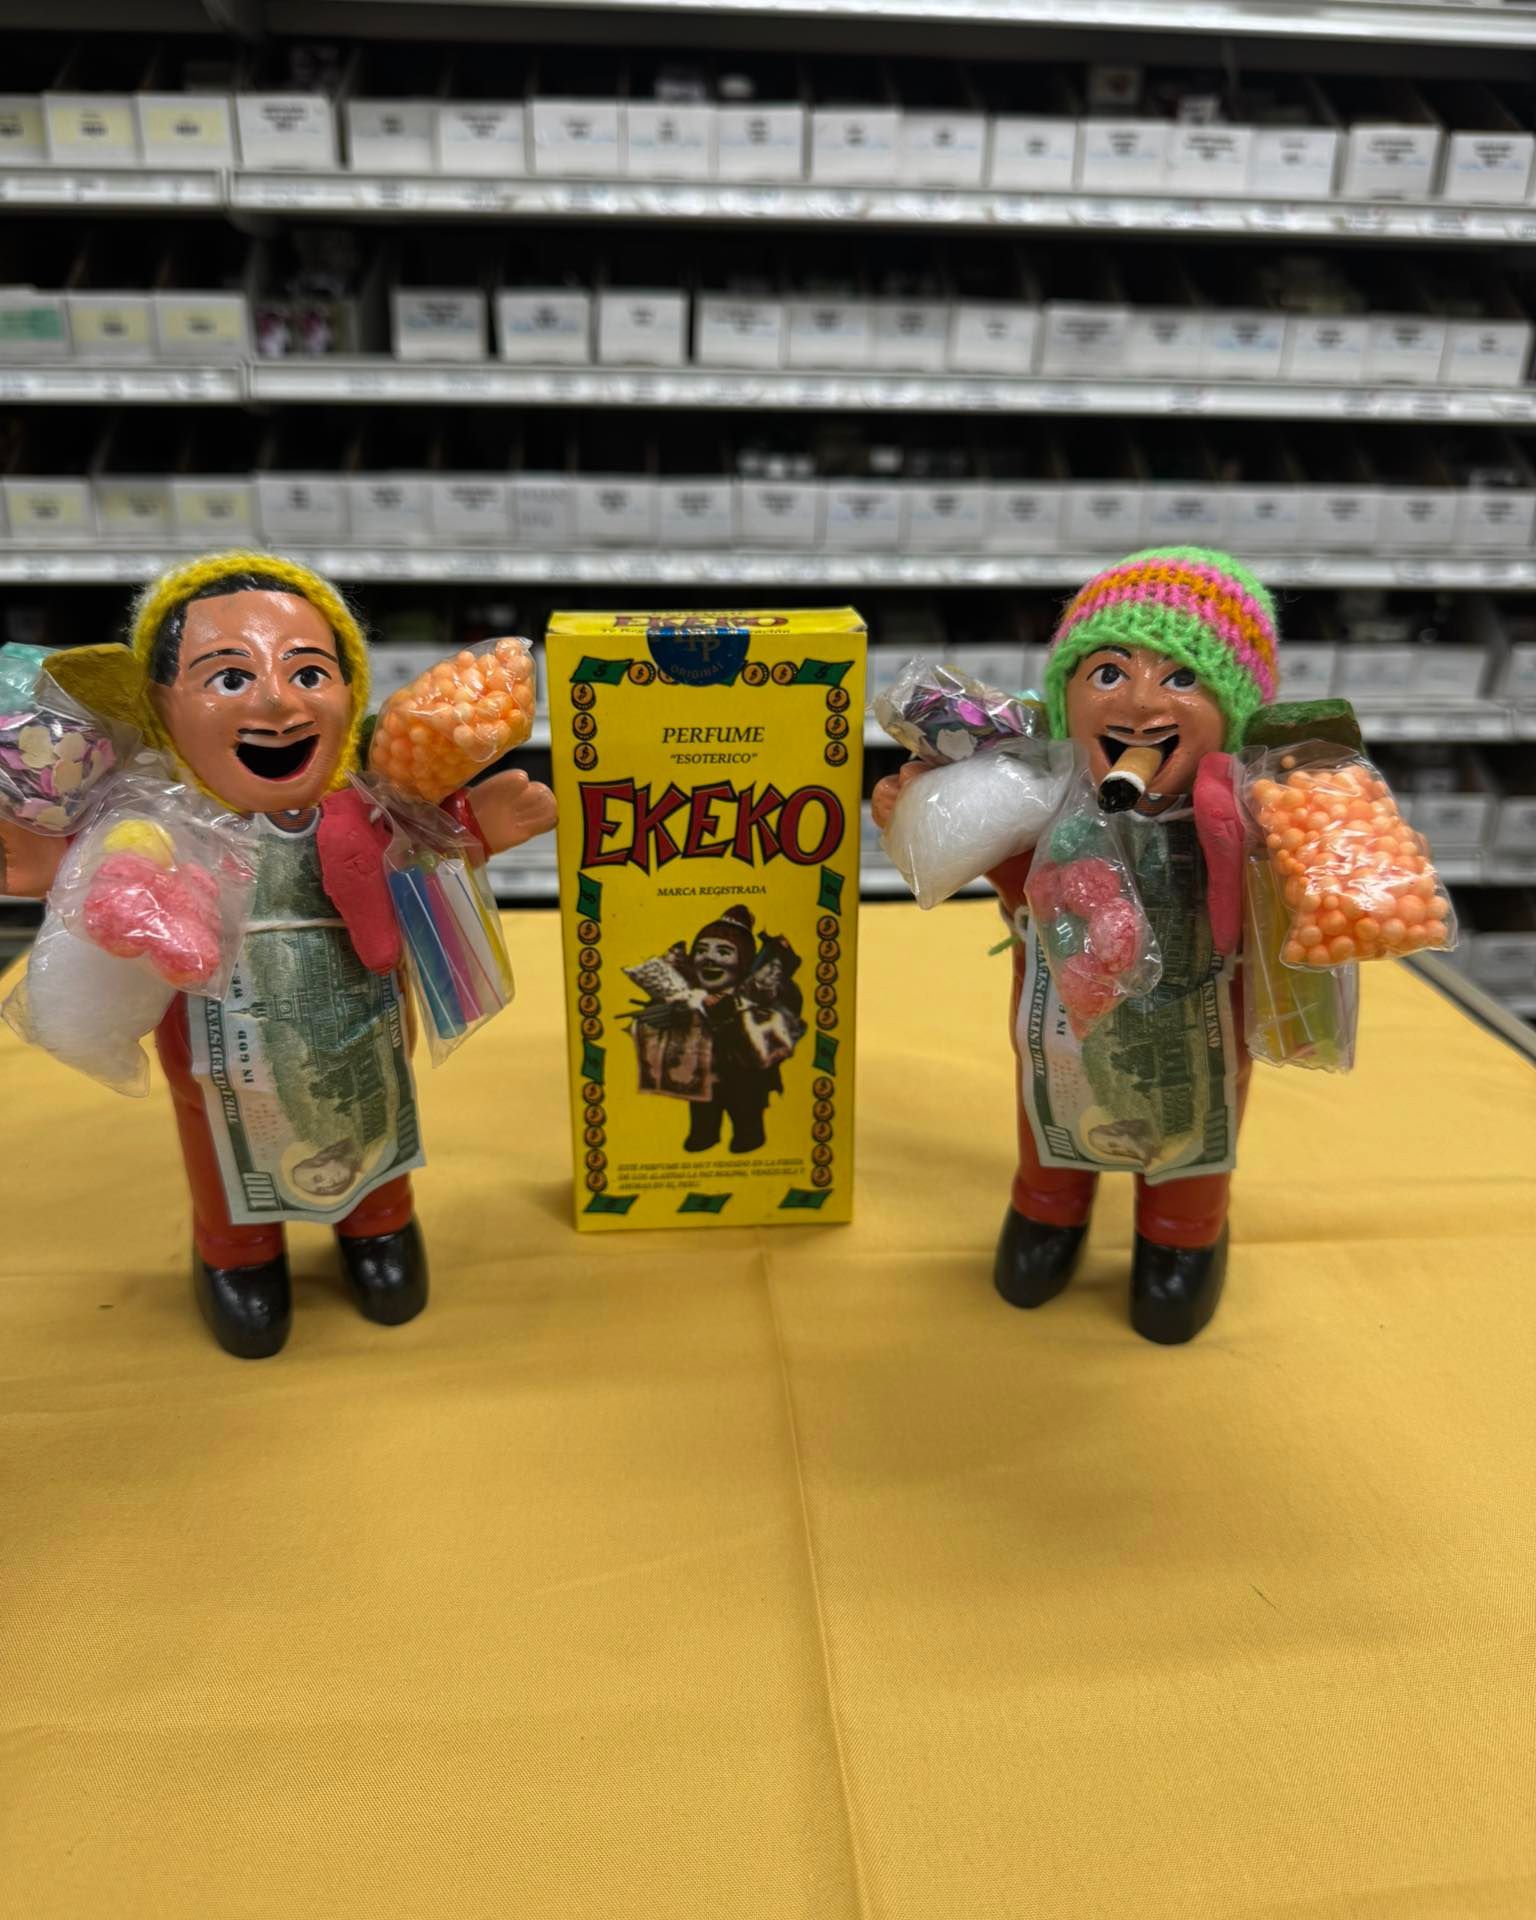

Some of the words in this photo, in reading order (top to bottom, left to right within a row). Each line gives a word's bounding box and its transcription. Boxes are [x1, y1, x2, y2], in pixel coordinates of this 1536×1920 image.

[614, 616, 789, 629] EKEKO
[661, 726, 765, 744] PERFUME
[670, 753, 758, 765] "ESOTERICO"
[578, 777, 846, 877] EKEKO
[657, 887, 697, 897] MARCA
[699, 885, 767, 897] REGISTRADA
[1056, 1020, 1067, 1035] IN
[237, 1030, 250, 1063] GOD
[242, 1069, 255, 1083] IN
